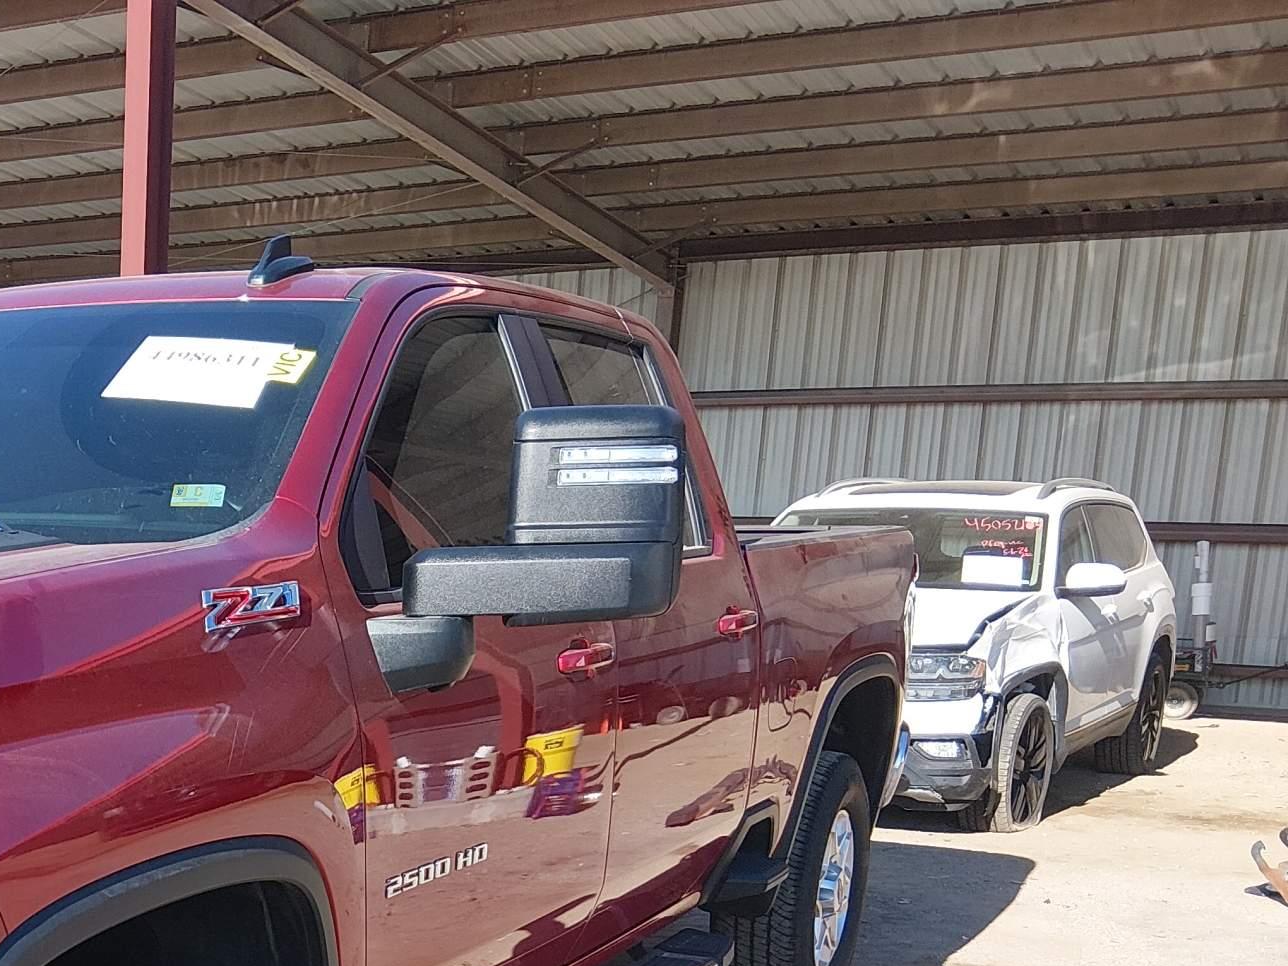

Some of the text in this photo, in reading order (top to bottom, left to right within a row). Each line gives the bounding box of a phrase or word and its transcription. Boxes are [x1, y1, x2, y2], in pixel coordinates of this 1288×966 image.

[267, 350, 303, 377] VIC
[201, 580, 300, 633] Z71
[385, 842, 488, 899] 2500 HD
